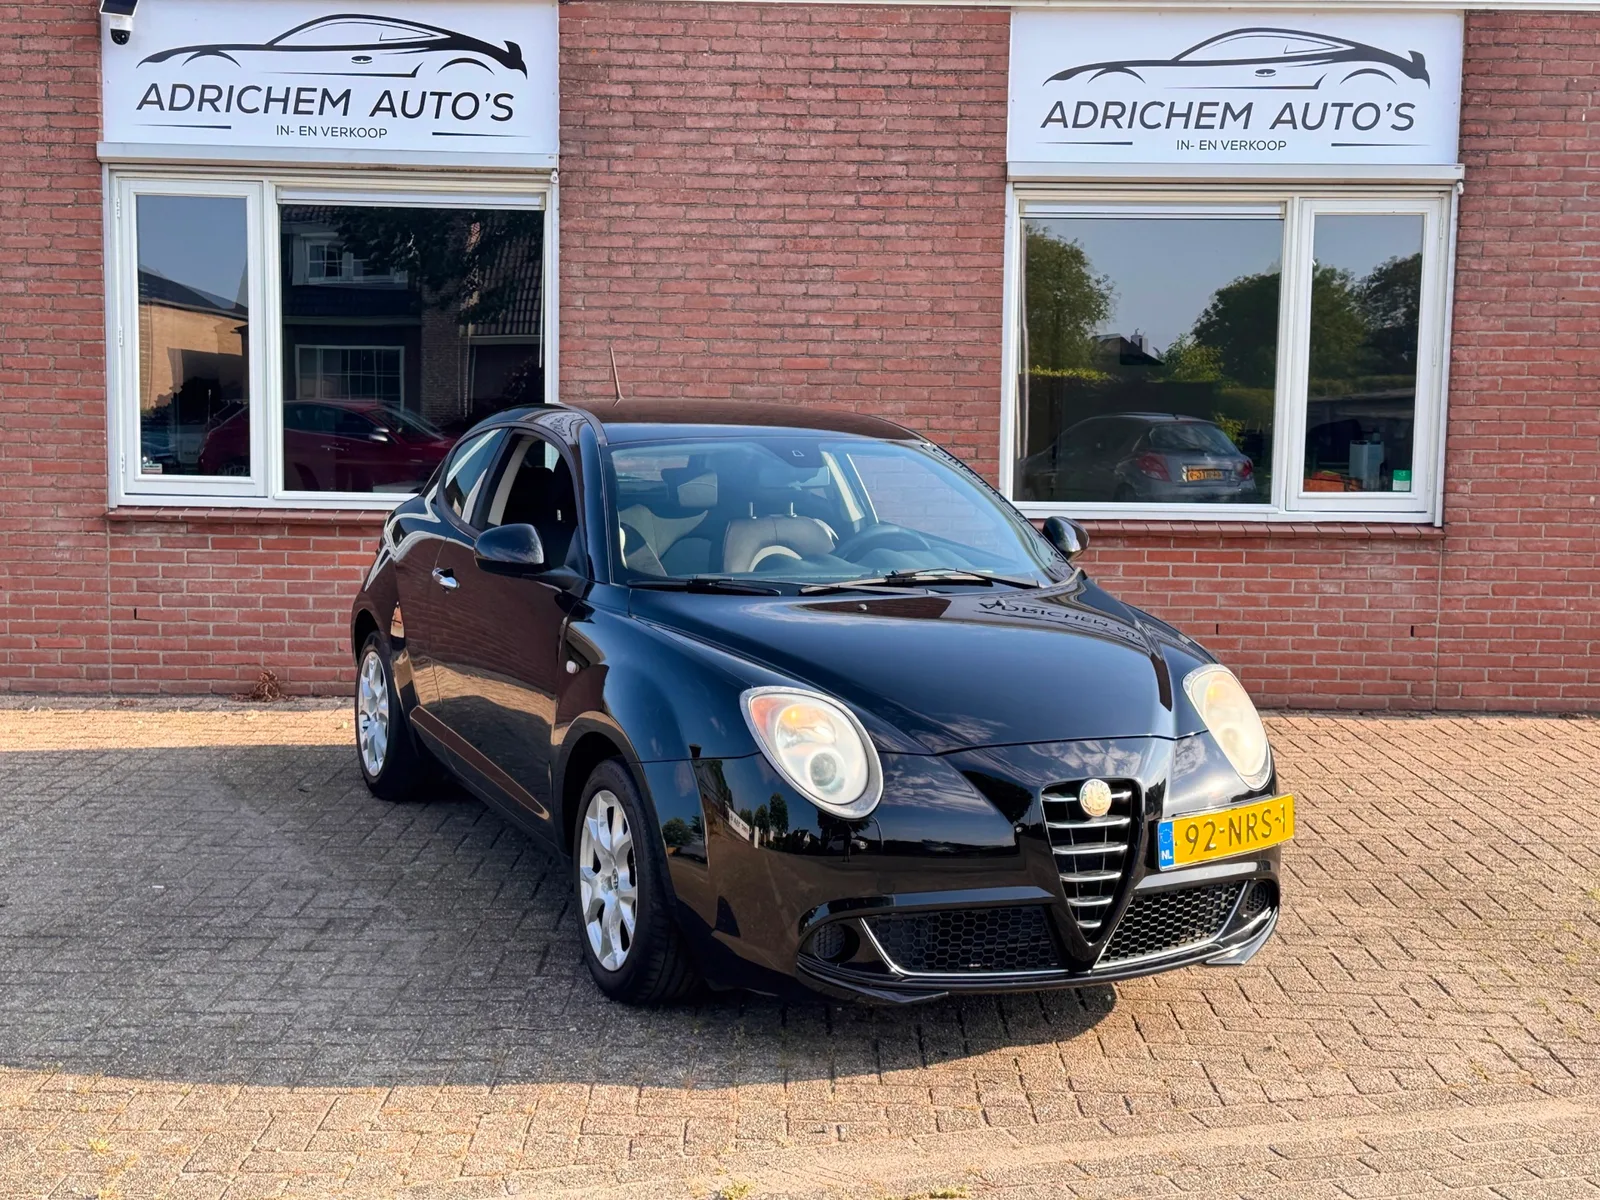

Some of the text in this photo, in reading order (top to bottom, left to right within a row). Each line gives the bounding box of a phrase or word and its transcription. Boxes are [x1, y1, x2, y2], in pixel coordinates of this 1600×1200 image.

[135, 82, 514, 122] ADRICHEM AUTO'S
[1040, 100, 1416, 132] ADRICHEM AUTO'S
[276, 124, 389, 139] IN- EN VERKOOP
[1176, 139, 1287, 151] IN- EN VERKOOP
[1184, 803, 1286, 855] 92-NRS-1
[1160, 850, 1173, 860] NL
